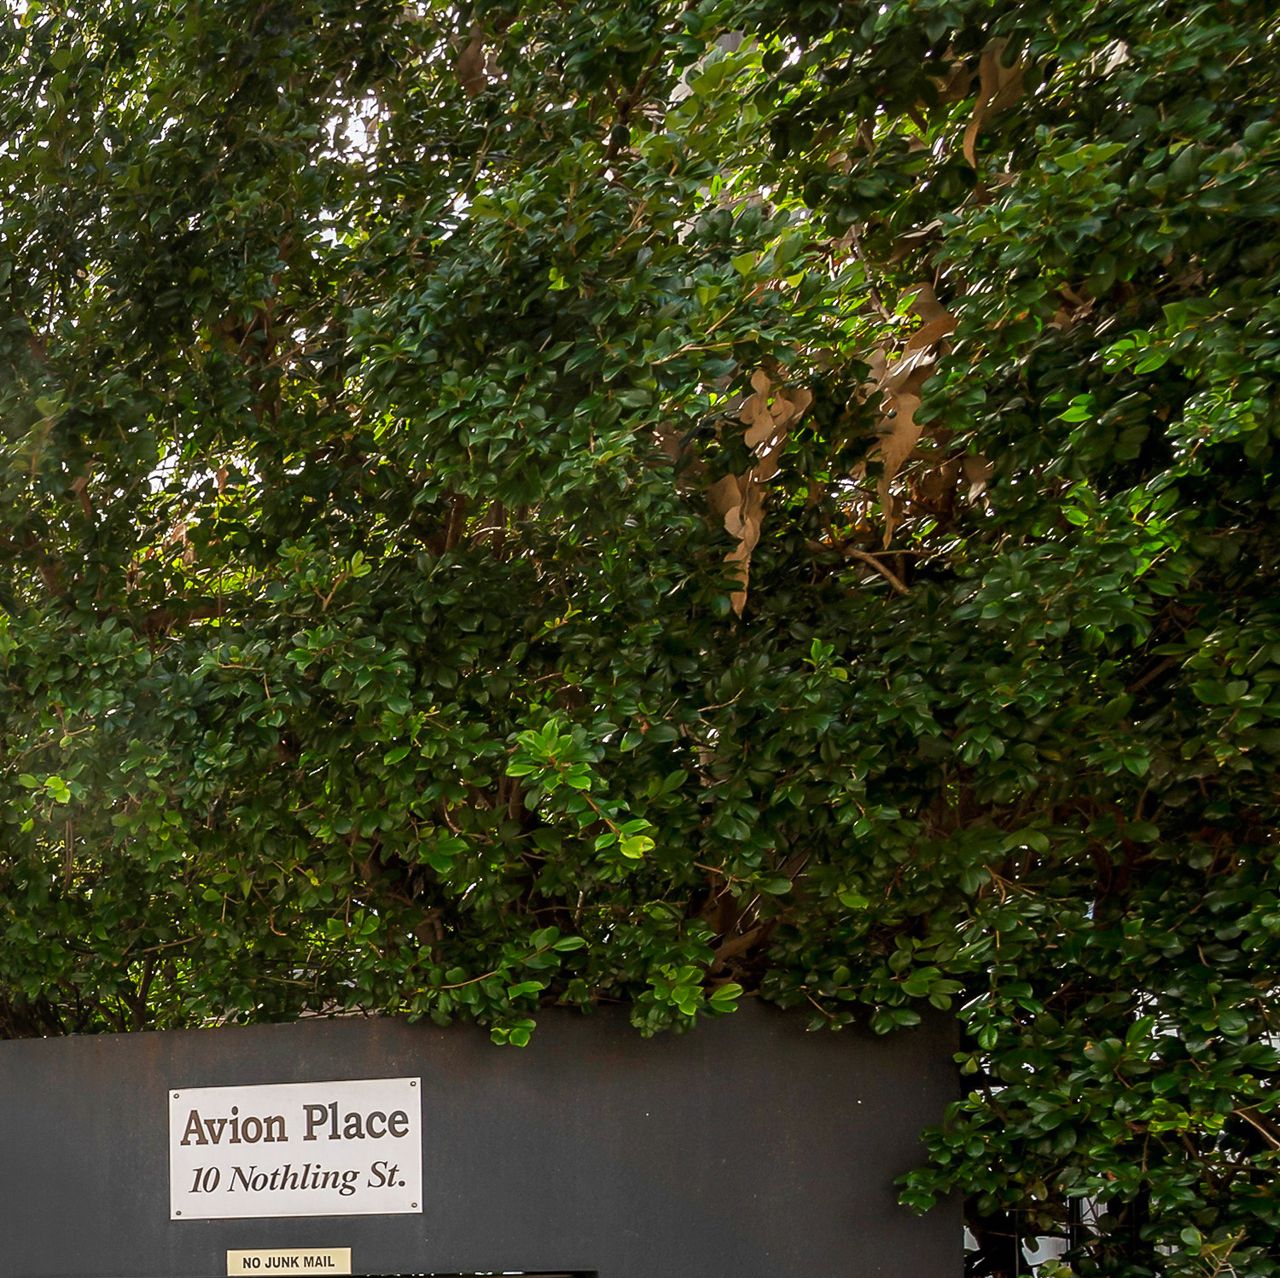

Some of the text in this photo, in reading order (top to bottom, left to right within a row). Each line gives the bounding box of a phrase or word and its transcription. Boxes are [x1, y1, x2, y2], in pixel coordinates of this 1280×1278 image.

[180, 1101, 410, 1146] Avion Place
[188, 1161, 406, 1196] 10 Nothling St.
[242, 1256, 335, 1269] NO JUNK MAIL
